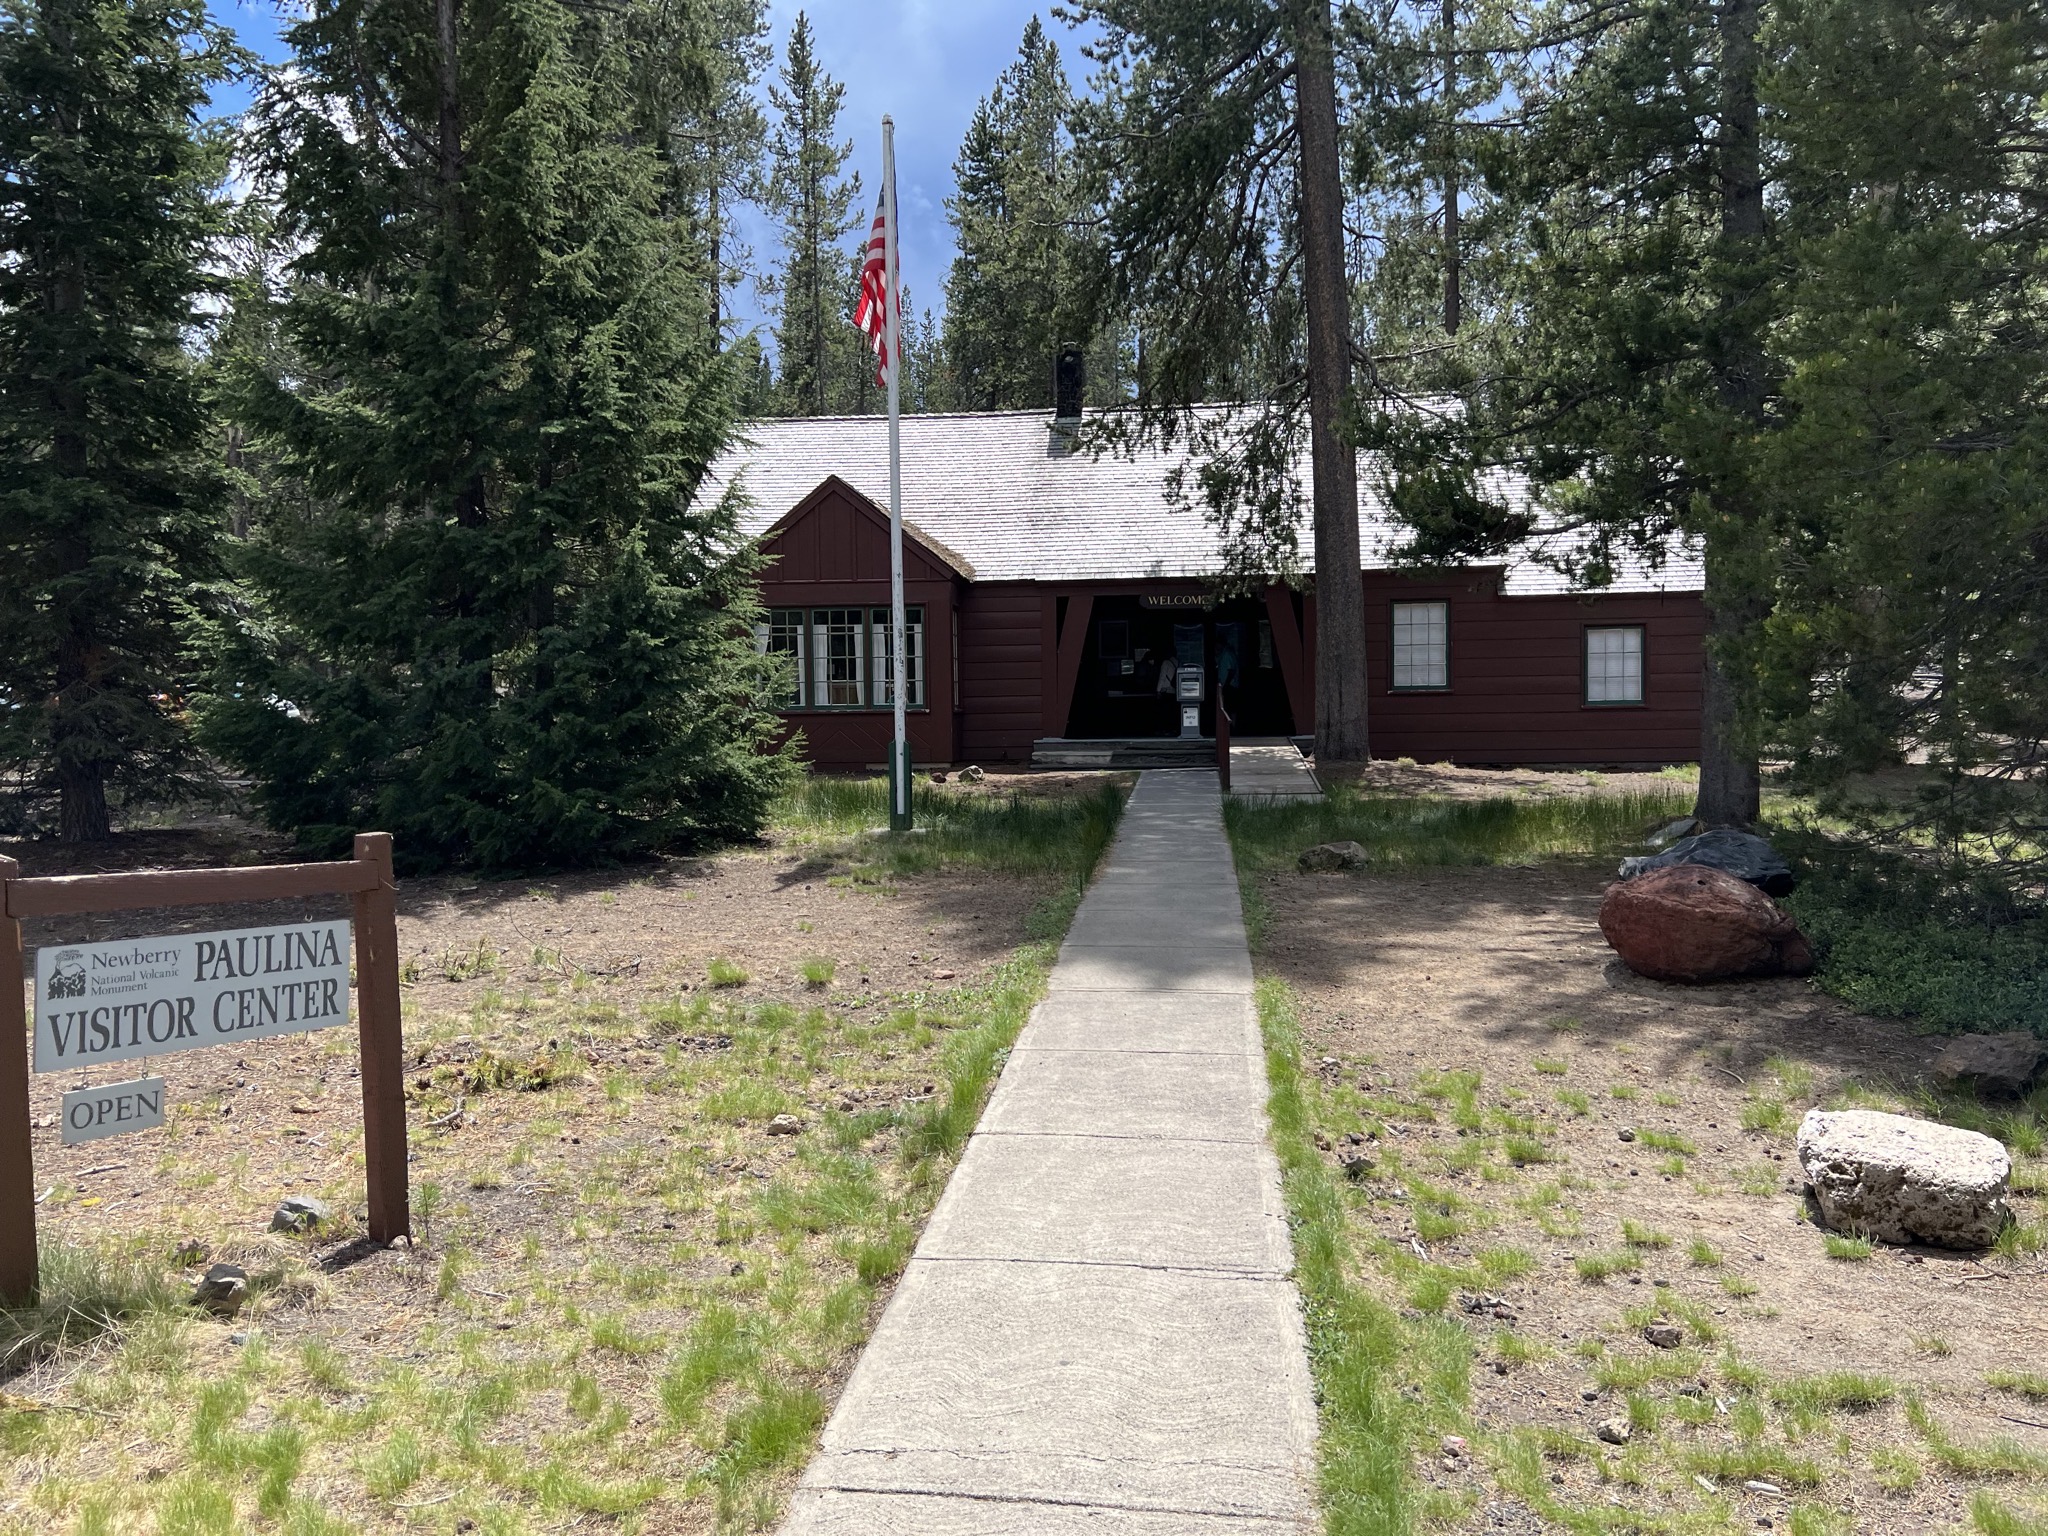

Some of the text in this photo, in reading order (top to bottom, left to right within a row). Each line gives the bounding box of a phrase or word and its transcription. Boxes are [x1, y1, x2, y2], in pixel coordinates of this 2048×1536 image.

[1148, 595, 1209, 605] WELCOME
[91, 947, 181, 970] Newberry
[194, 928, 342, 983] PAULINA
[91, 968, 180, 986] National Volcanic
[90, 982, 148, 996] Monument
[48, 977, 341, 1057] VISITOR CENTER
[70, 1090, 160, 1130] OPEN
